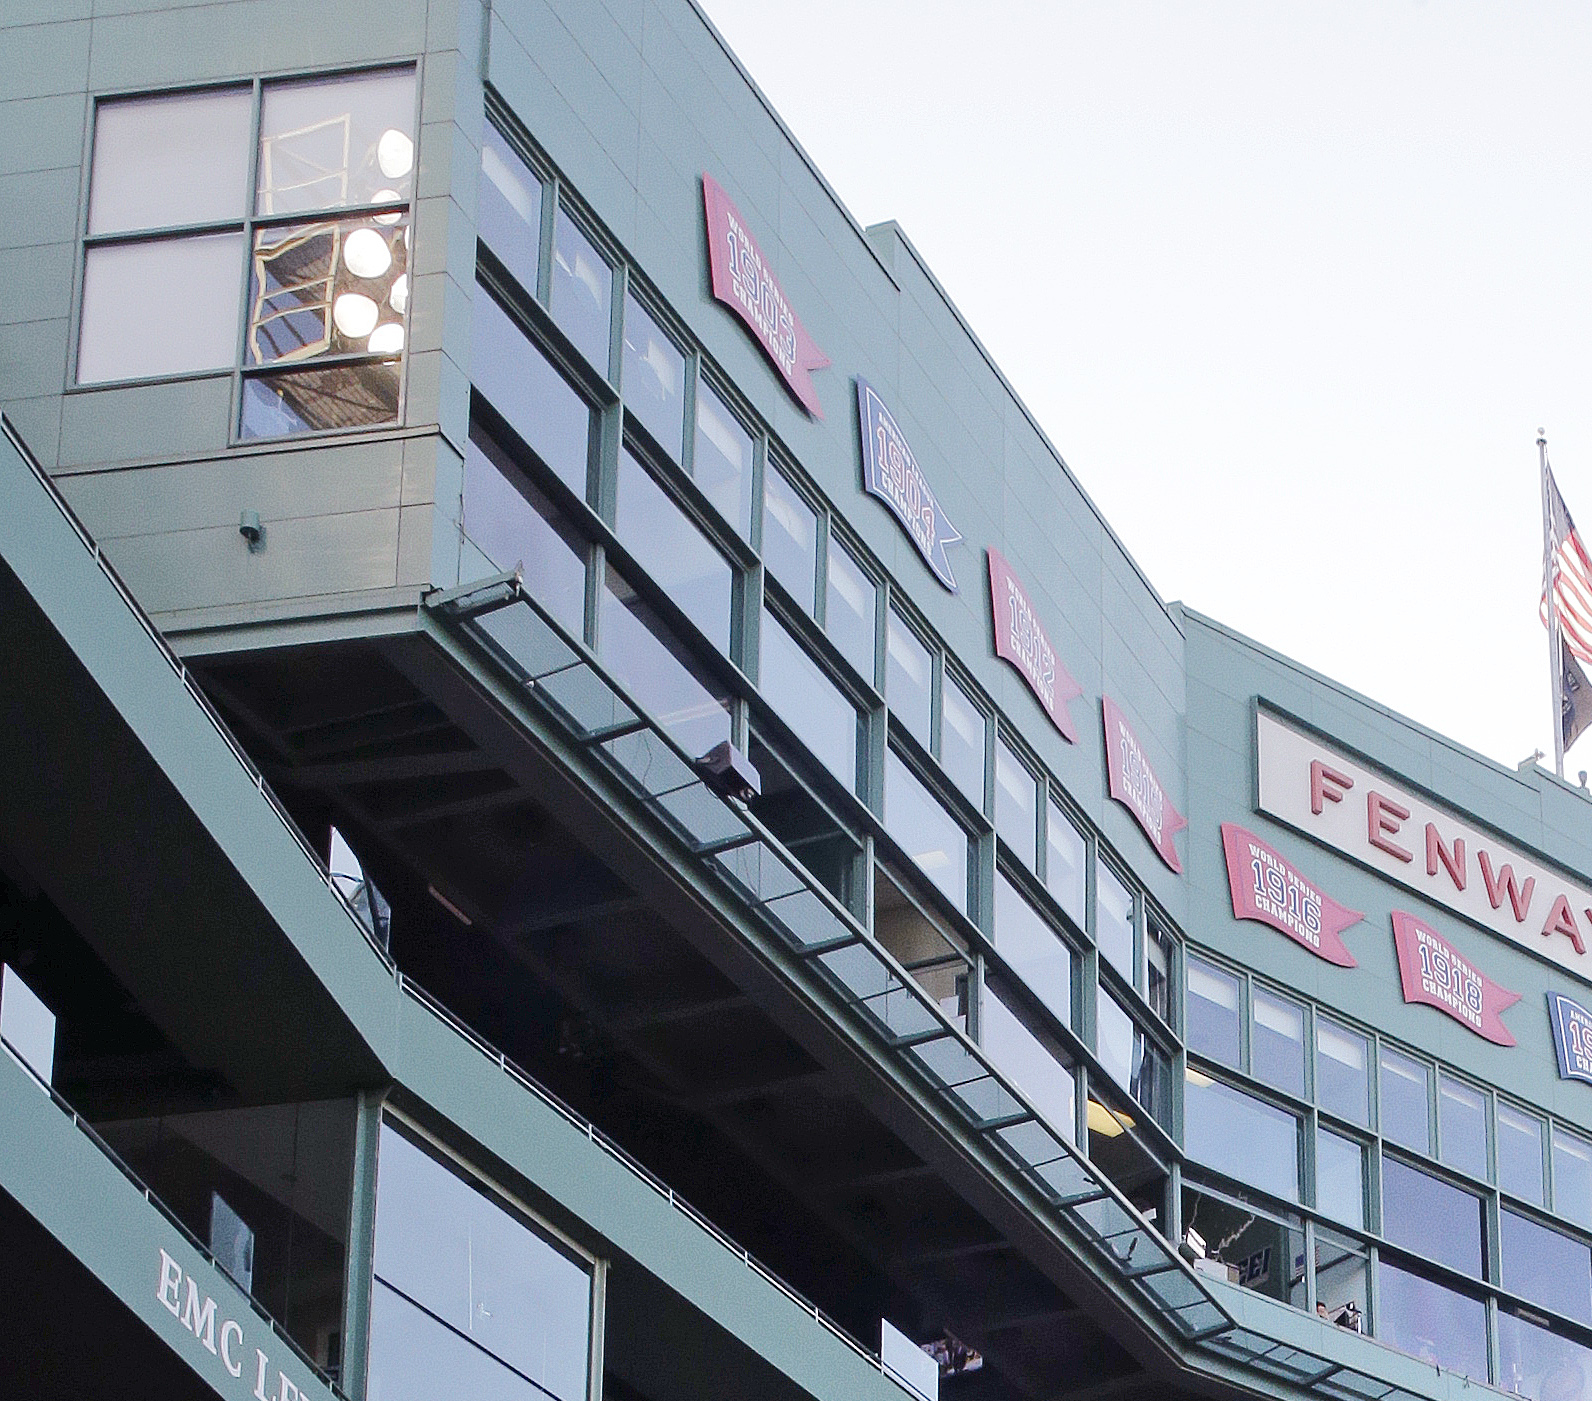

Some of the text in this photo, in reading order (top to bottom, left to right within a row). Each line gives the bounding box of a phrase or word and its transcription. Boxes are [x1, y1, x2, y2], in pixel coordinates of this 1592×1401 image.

[727, 212, 762, 270] WORLD
[727, 232, 796, 364] 1903
[732, 279, 792, 376] CHAMPIONS
[877, 426, 935, 546] 1904
[1009, 596, 1055, 697] 1912
[1248, 843, 1322, 906] WORLD SERIES
[1251, 859, 1321, 933] 1916
[1255, 894, 1320, 949] CHAMPIONS
[1415, 928, 1482, 987] WORLD SERIES
[1418, 944, 1482, 1014] 1918
[1422, 978, 1482, 1028] CHAMPIONS
[156, 1248, 243, 1378] EMC
